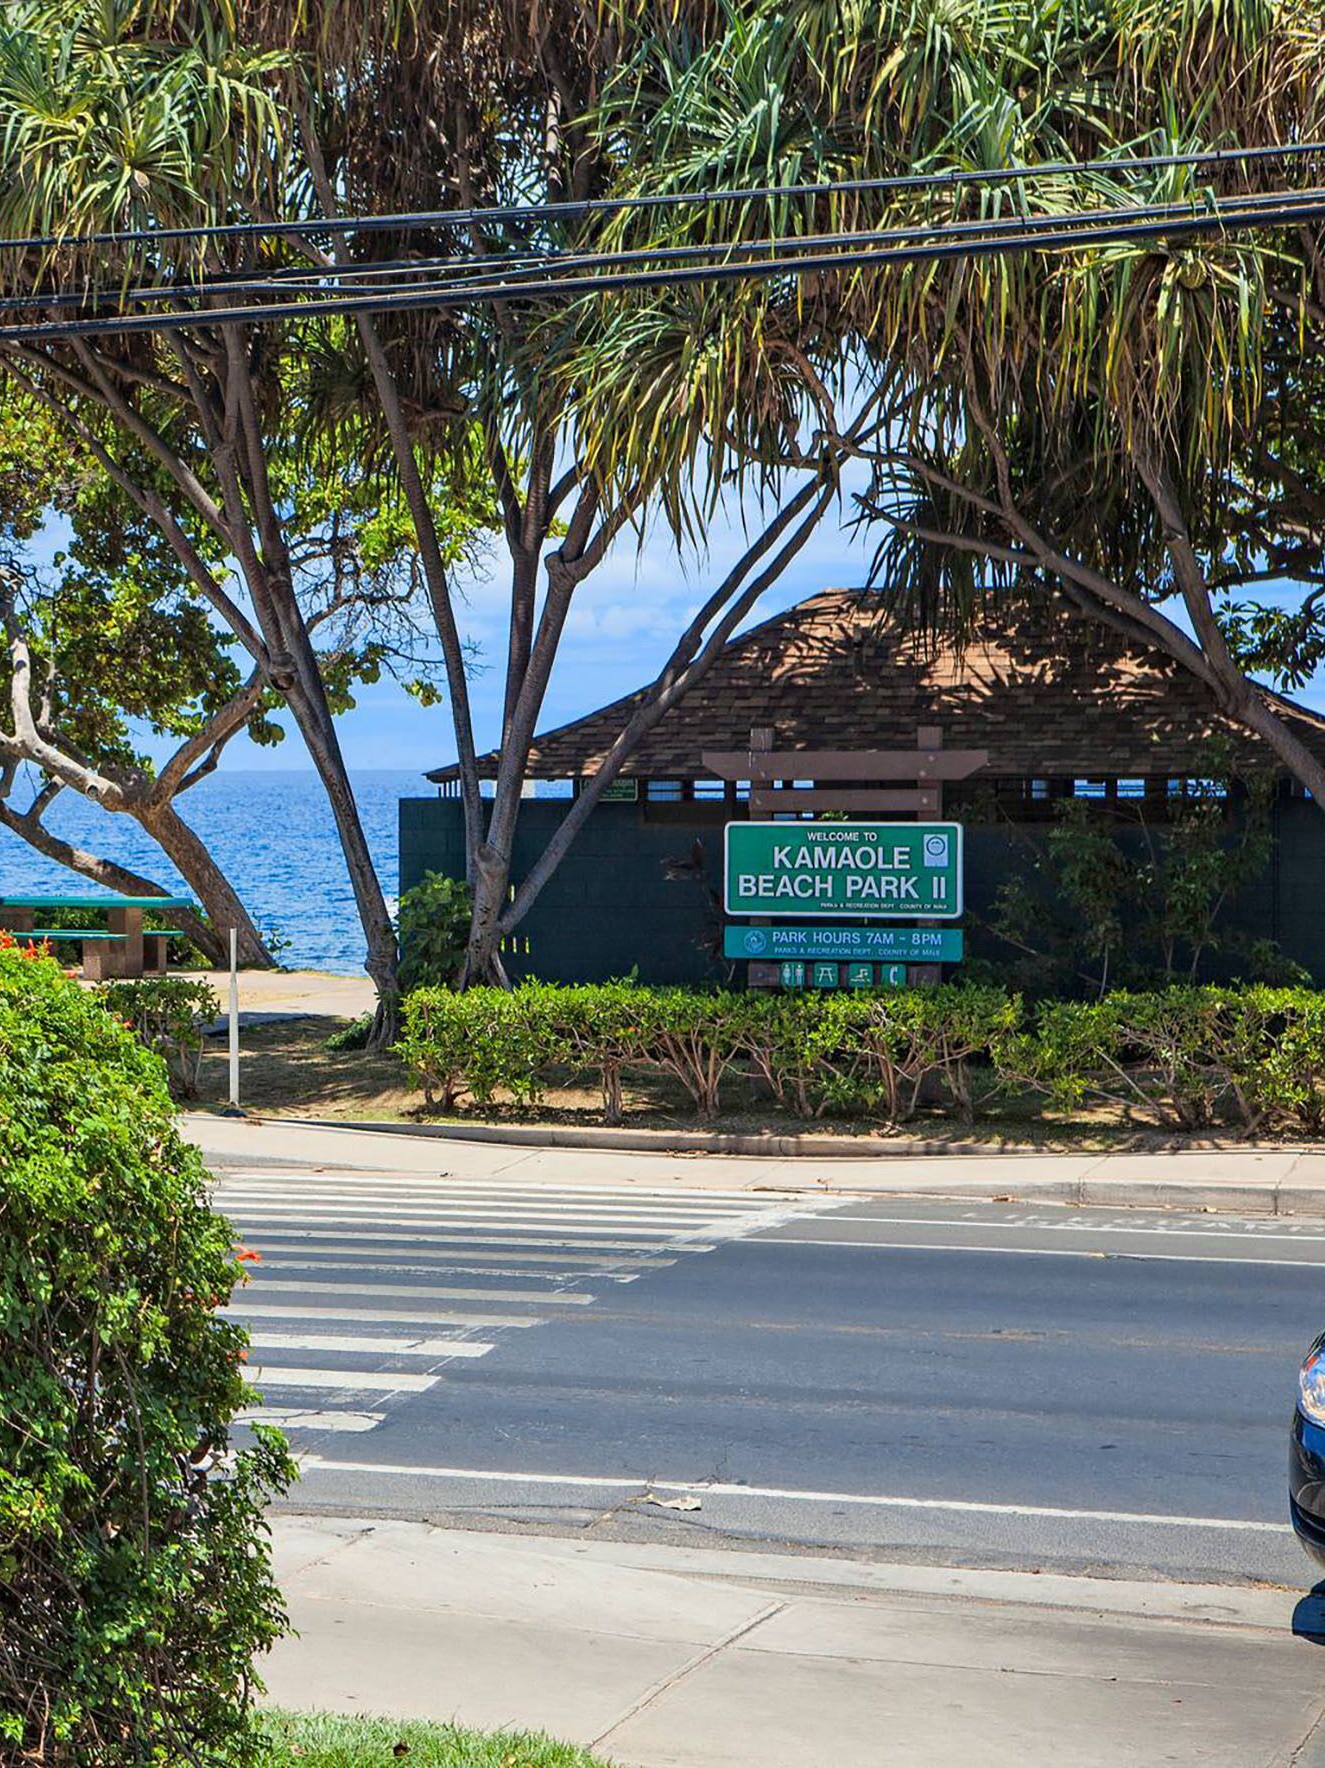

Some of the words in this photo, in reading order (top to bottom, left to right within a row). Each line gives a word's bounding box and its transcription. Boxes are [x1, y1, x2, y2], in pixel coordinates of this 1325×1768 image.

[807, 832, 859, 842] WELCOME
[863, 832, 878, 842] TO
[773, 846, 911, 870] KAMAOLE
[738, 874, 833, 897] BEACH
[845, 876, 919, 899] PARK
[932, 876, 946, 899] II
[772, 931, 807, 943] PARK
[812, 932, 861, 944] HOURS
[866, 933, 894, 945] 7AM
[911, 933, 942, 945] 8PM
